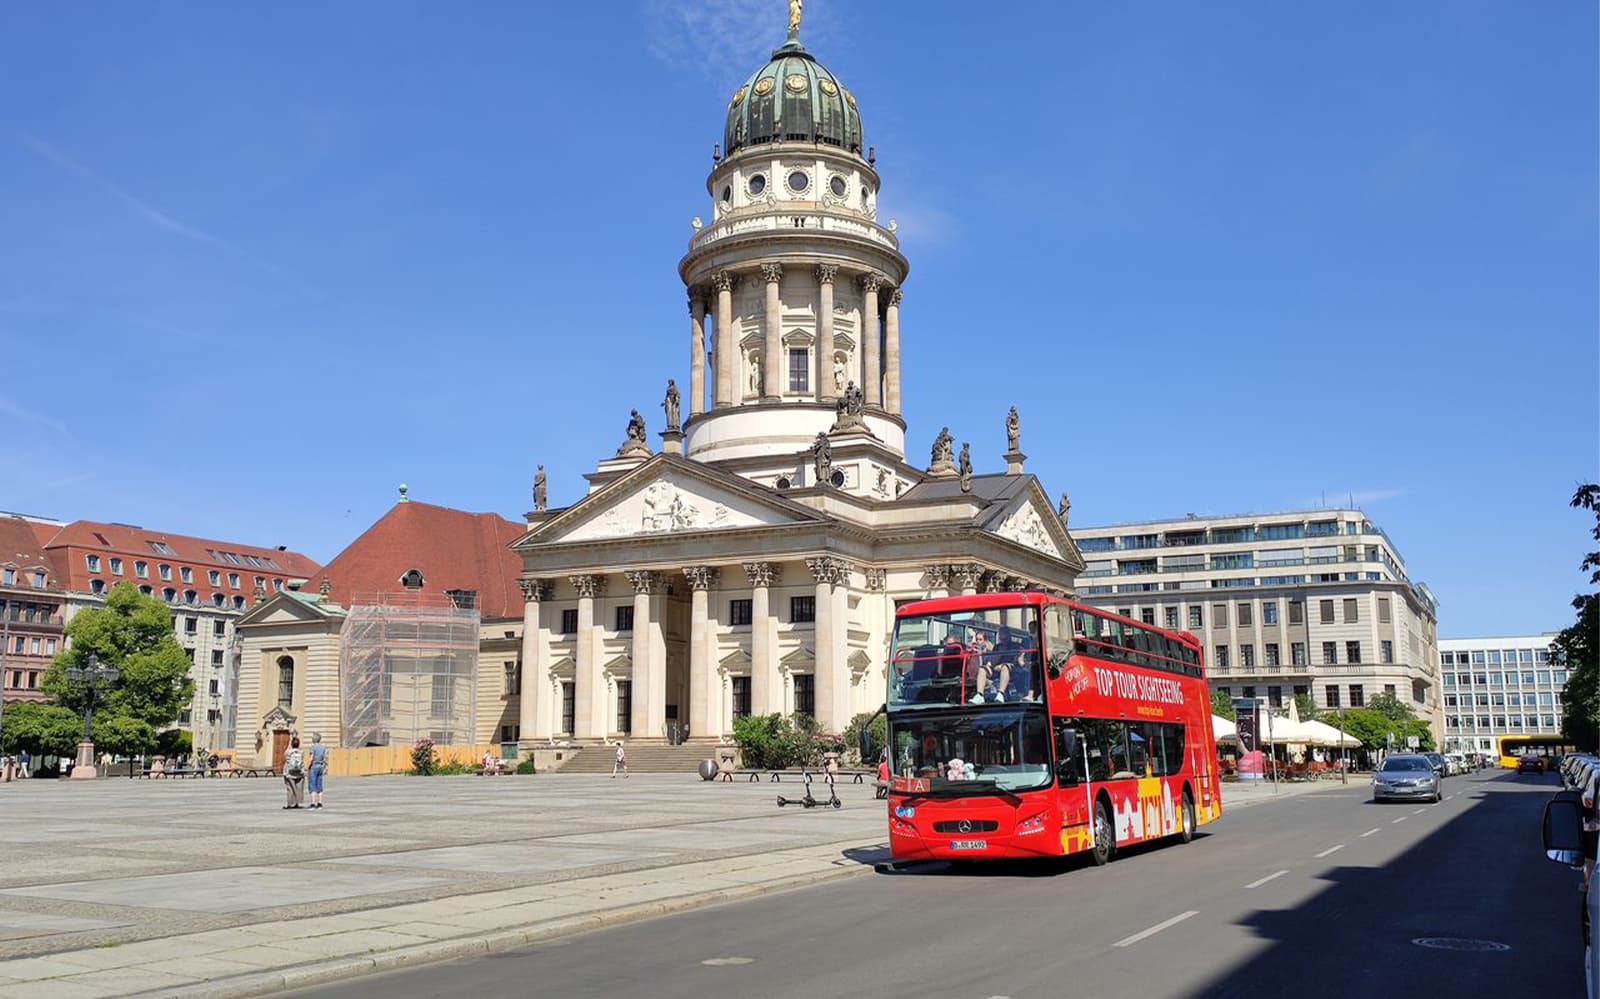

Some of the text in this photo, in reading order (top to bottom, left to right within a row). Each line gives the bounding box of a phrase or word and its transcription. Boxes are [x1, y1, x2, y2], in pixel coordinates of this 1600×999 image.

[1094, 667, 1184, 705] TOP TOUR SIGHTSEEING
[915, 779, 925, 791] A
